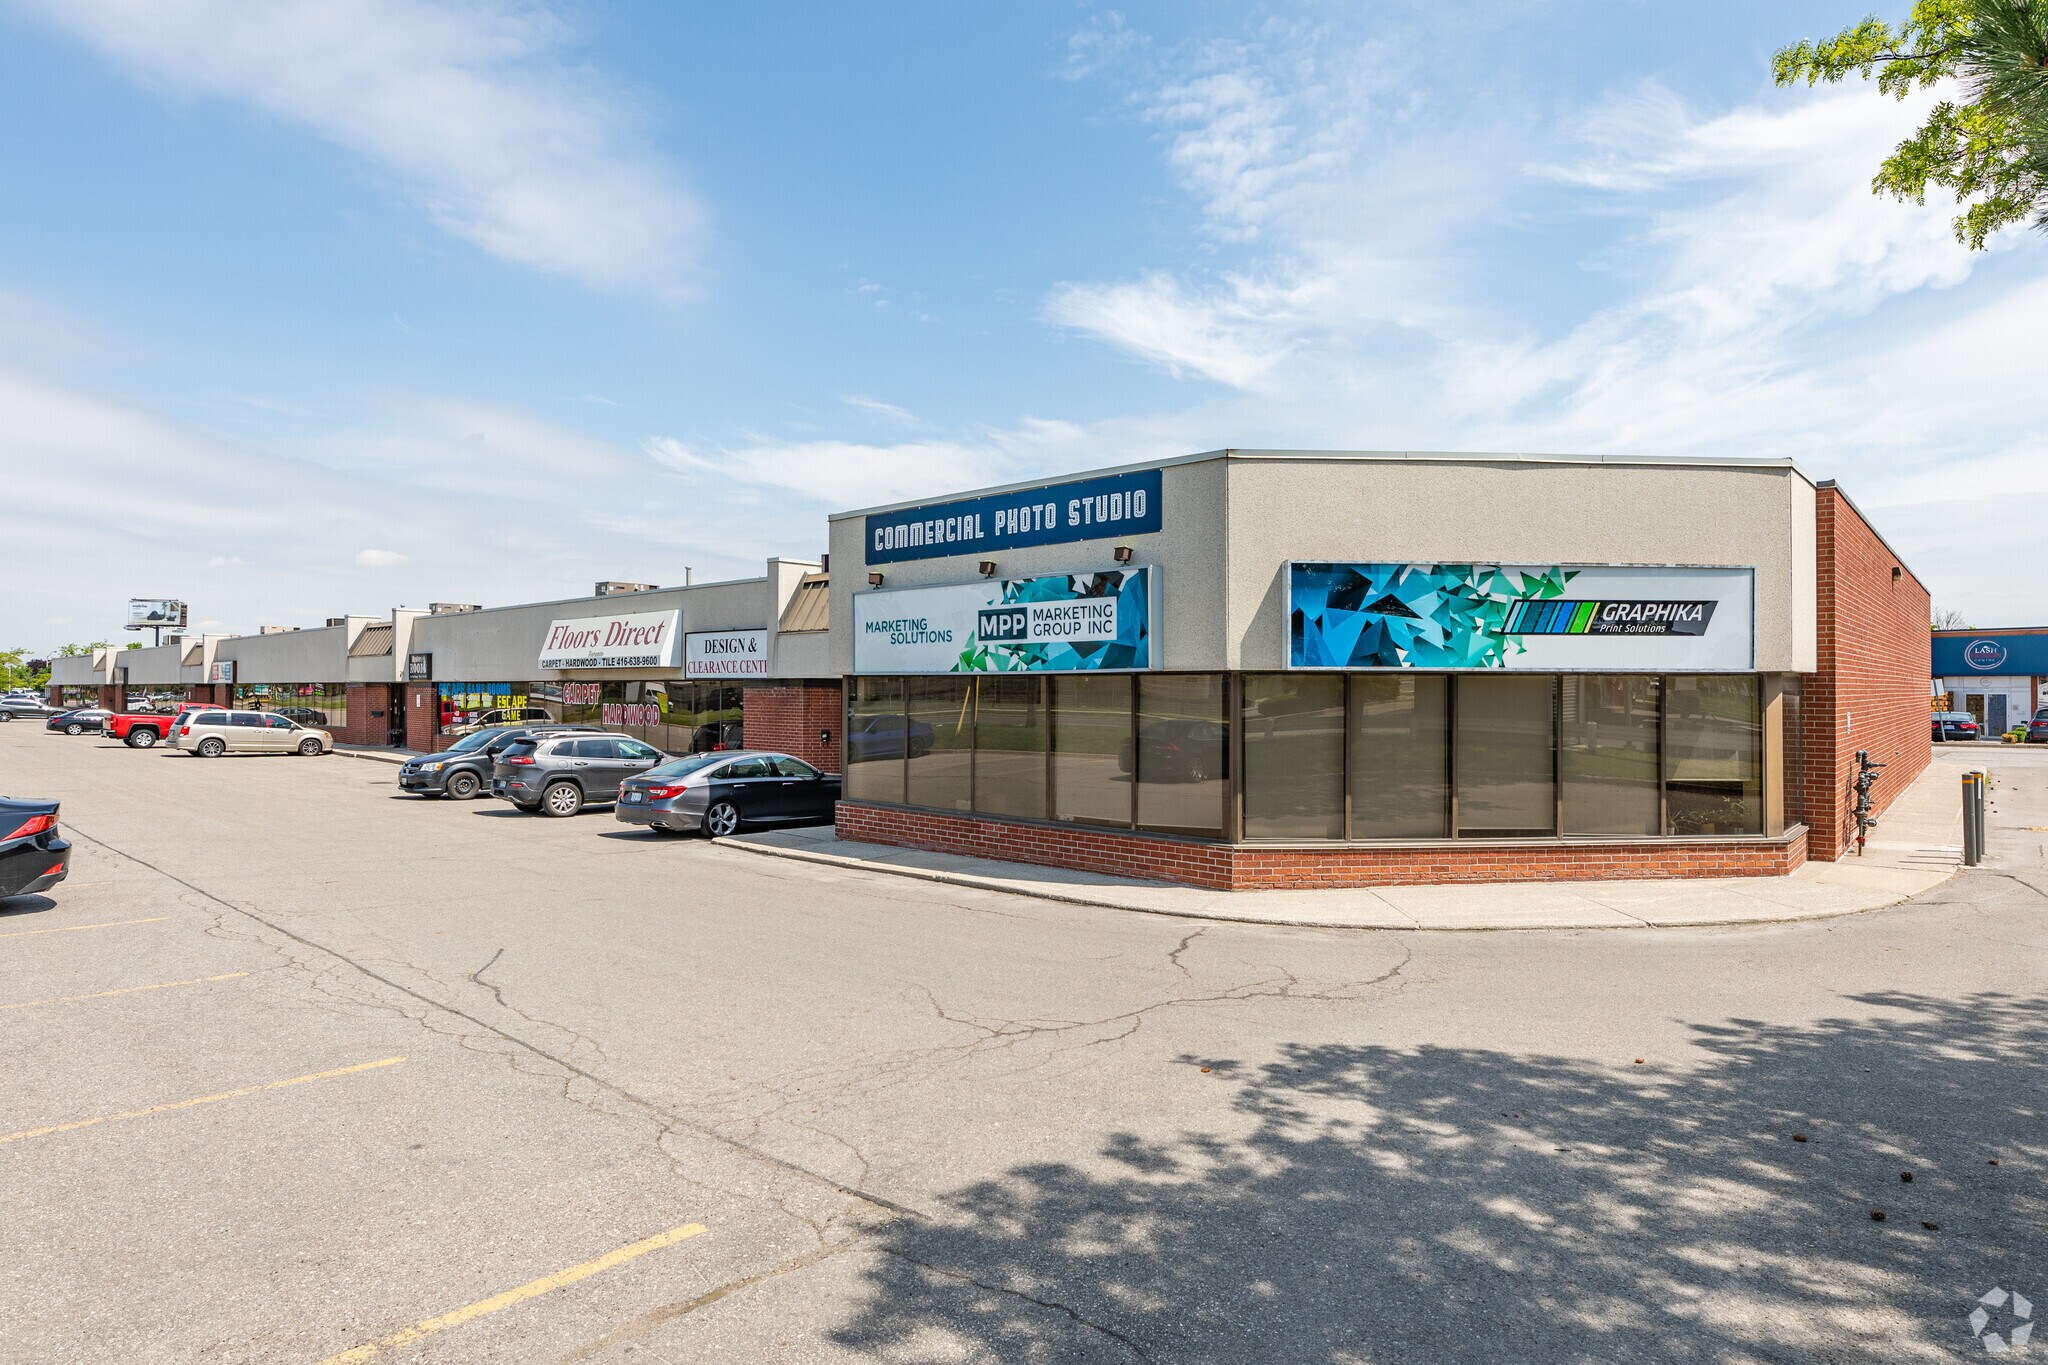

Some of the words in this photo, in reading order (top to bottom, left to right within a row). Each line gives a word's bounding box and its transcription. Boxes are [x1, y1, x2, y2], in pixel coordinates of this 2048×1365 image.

[875, 514, 984, 551] COMMERCIAL
[995, 502, 1056, 536] PHOTO
[1068, 489, 1147, 526] STUDIO
[1033, 604, 1113, 622] MARKETING
[1602, 603, 1703, 621] GRAPHIKA
[865, 618, 928, 634] MARKETING
[980, 613, 1026, 637] MPP
[1033, 621, 1082, 637] GROUP
[1088, 620, 1113, 635] INC
[1600, 624, 1622, 633] Print
[1625, 624, 1666, 633] Solutions
[547, 624, 602, 650] Floors
[602, 620, 665, 648] Direct
[890, 630, 953, 645] SOLUTIONS
[704, 638, 746, 654] DESIGN
[748, 637, 757, 653] &
[542, 660, 561, 668] CARPET
[566, 658, 598, 667] HARDWOOD
[602, 658, 615, 666] TILE
[616, 656, 658, 666] 416-638-9600
[688, 660, 738, 674] CLEARANCE
[497, 696, 527, 708] ESCAPE
[562, 684, 600, 704] CARPET
[502, 710, 520, 720] GAME
[602, 703, 661, 726] HARDWOOD
